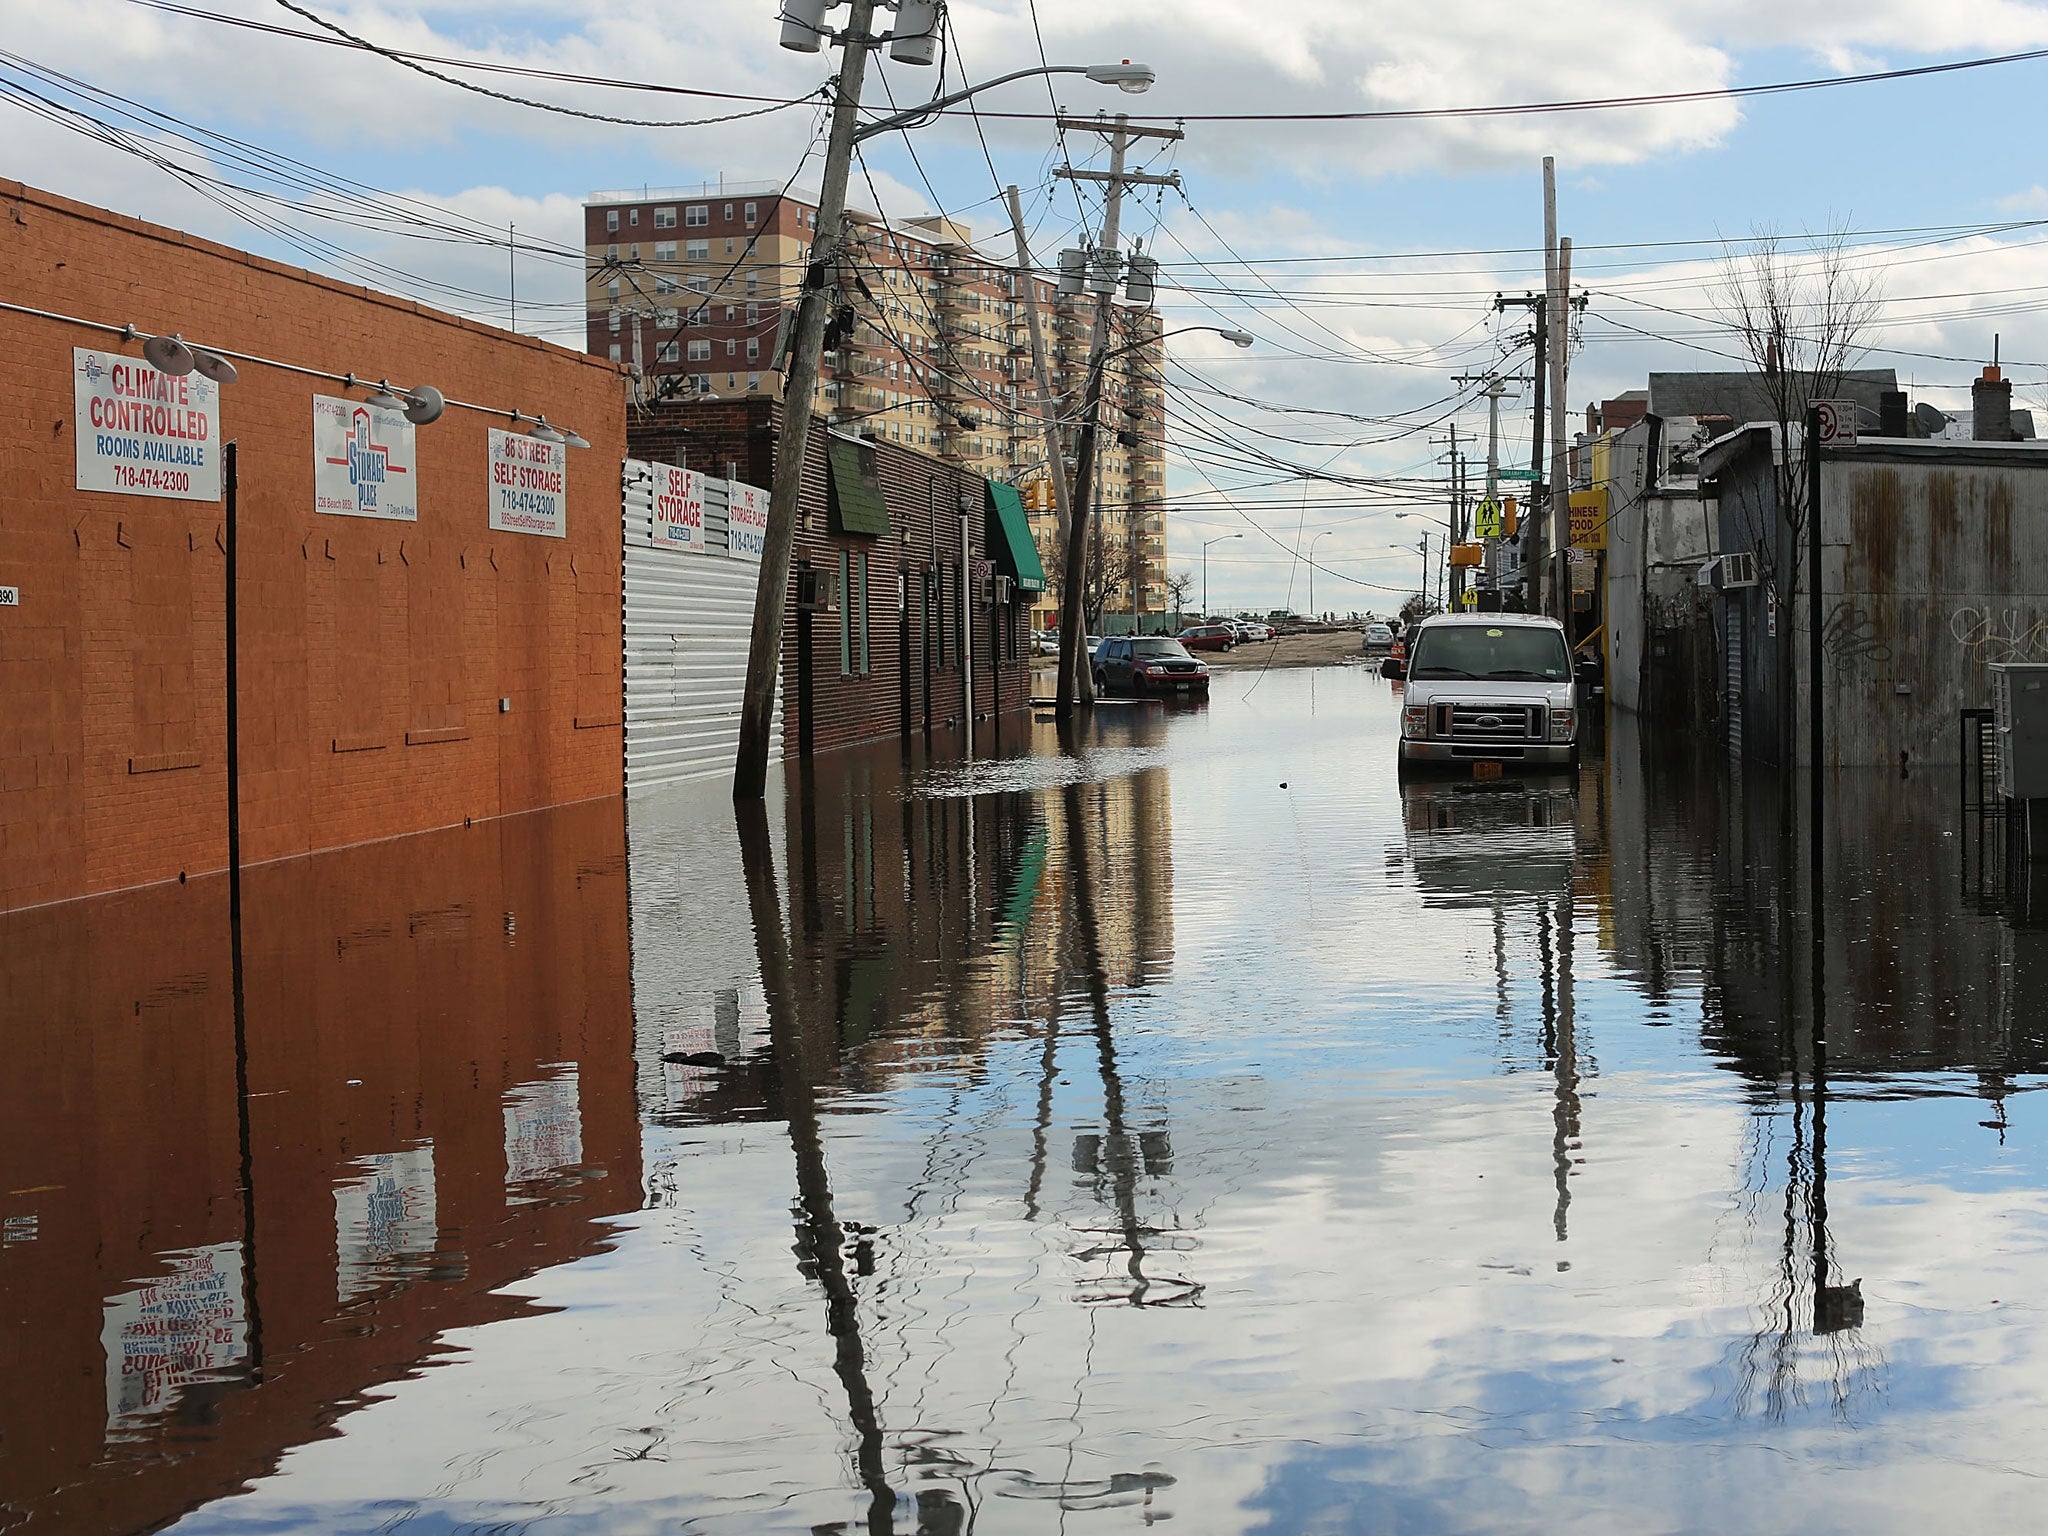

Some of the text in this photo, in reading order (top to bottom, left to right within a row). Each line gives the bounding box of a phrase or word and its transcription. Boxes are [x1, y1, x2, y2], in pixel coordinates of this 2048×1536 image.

[112, 364, 189, 405] CLIMATE
[90, 396, 208, 441] CONTROLLED
[356, 420, 367, 449] THE
[97, 434, 204, 466] ROOMS AVAILABLE
[349, 441, 385, 485] STORAGE
[505, 437, 515, 459] 88
[518, 439, 552, 465] STREET
[114, 465, 189, 492] 718-474-2300
[494, 461, 562, 493] SELF STORAGE
[668, 469, 691, 498] SELF
[358, 483, 377, 511] PLACE
[390, 504, 401, 517] Days
[401, 505, 405, 514] A
[501, 489, 555, 515] 718-474-2300
[658, 494, 701, 528] STORAGE
[745, 491, 754, 508] THE
[730, 505, 766, 528] STORAGE PLACE
[1569, 506, 1599, 517] HINESE
[1570, 520, 1593, 531] FOOD
[730, 530, 764, 555] 718-474-230
